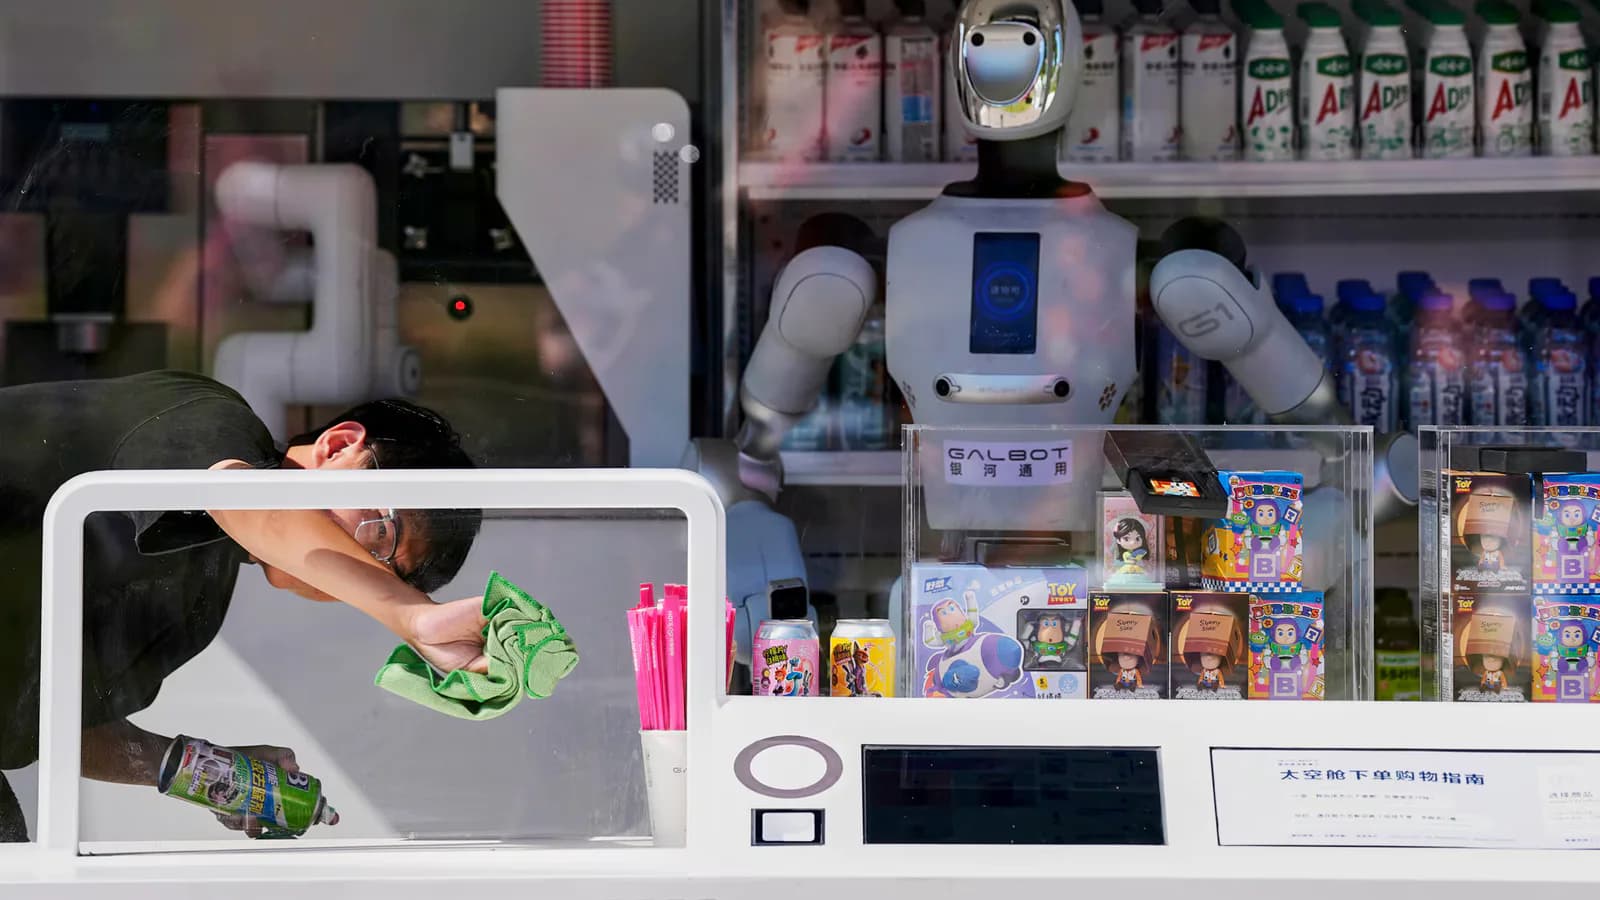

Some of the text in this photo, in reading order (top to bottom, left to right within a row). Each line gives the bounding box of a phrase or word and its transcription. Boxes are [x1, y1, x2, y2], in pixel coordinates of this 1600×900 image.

[948, 447, 1069, 461] GALBOT
[950, 462, 1067, 477] 银河通用
[1256, 557, 1274, 574] B
[1563, 559, 1582, 575] B
[1048, 582, 1077, 596] TOY
[1093, 598, 1111, 607] TOY
[1176, 598, 1193, 606] TOY
[1457, 600, 1474, 608] TOY
[1277, 677, 1295, 694] B
[1563, 680, 1582, 696] B
[1280, 769, 1485, 785] 太空舱下单购物指南
